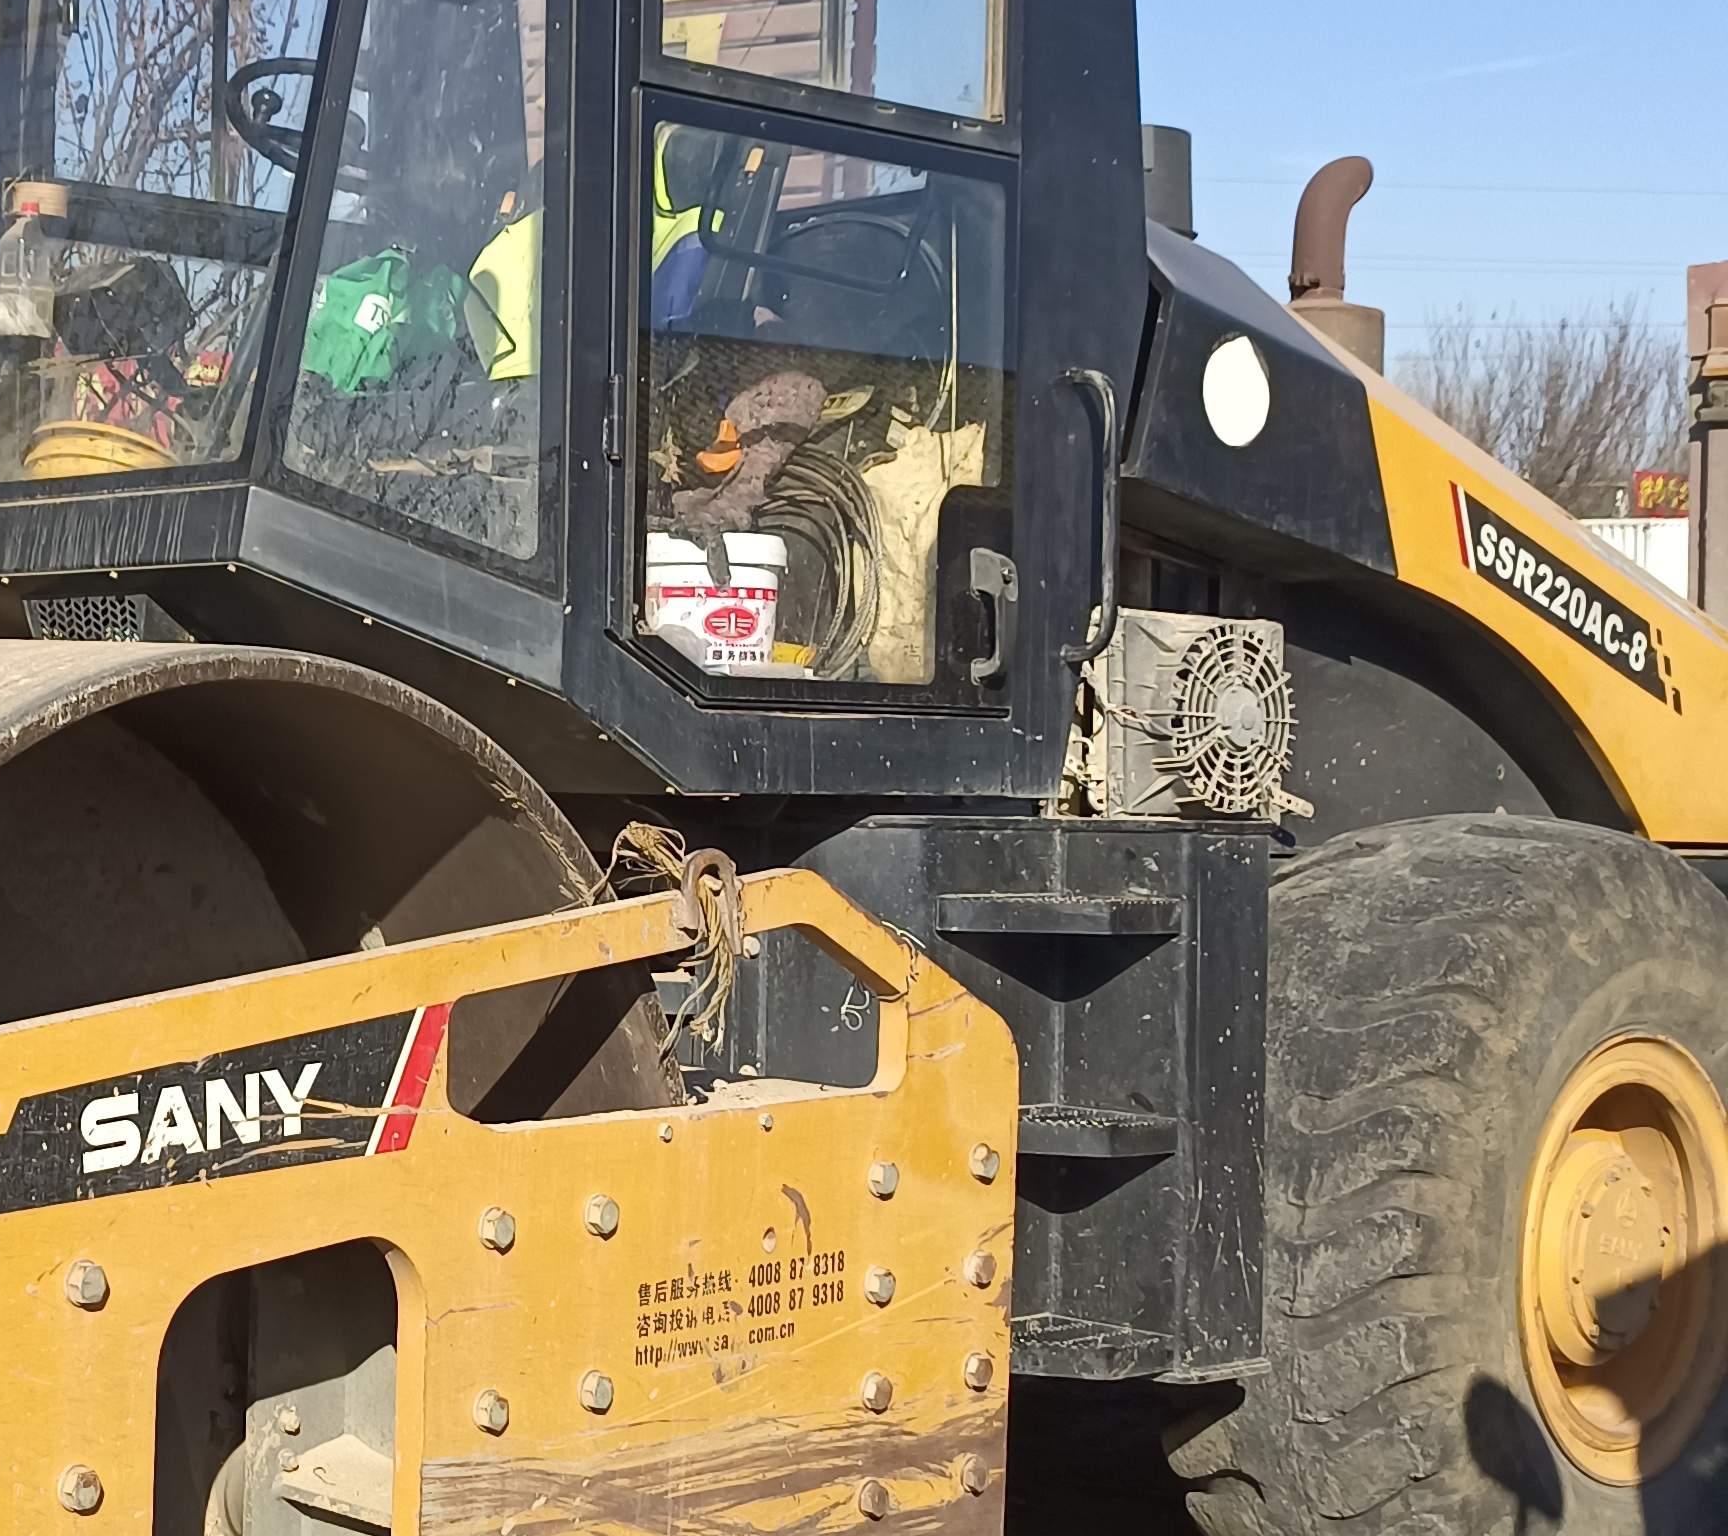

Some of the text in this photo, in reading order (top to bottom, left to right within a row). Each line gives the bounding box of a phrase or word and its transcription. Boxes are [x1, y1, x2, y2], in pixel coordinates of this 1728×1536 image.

[1476, 522, 1648, 673] SSR220AC-8
[79, 1062, 323, 1174] SANY
[747, 1291, 781, 1318] 4008
[788, 1287, 805, 1311] 87
[812, 1280, 844, 1306] 9318
[748, 1261, 781, 1288] 4008
[789, 1257, 805, 1280] 87
[813, 1250, 845, 1276] 8318
